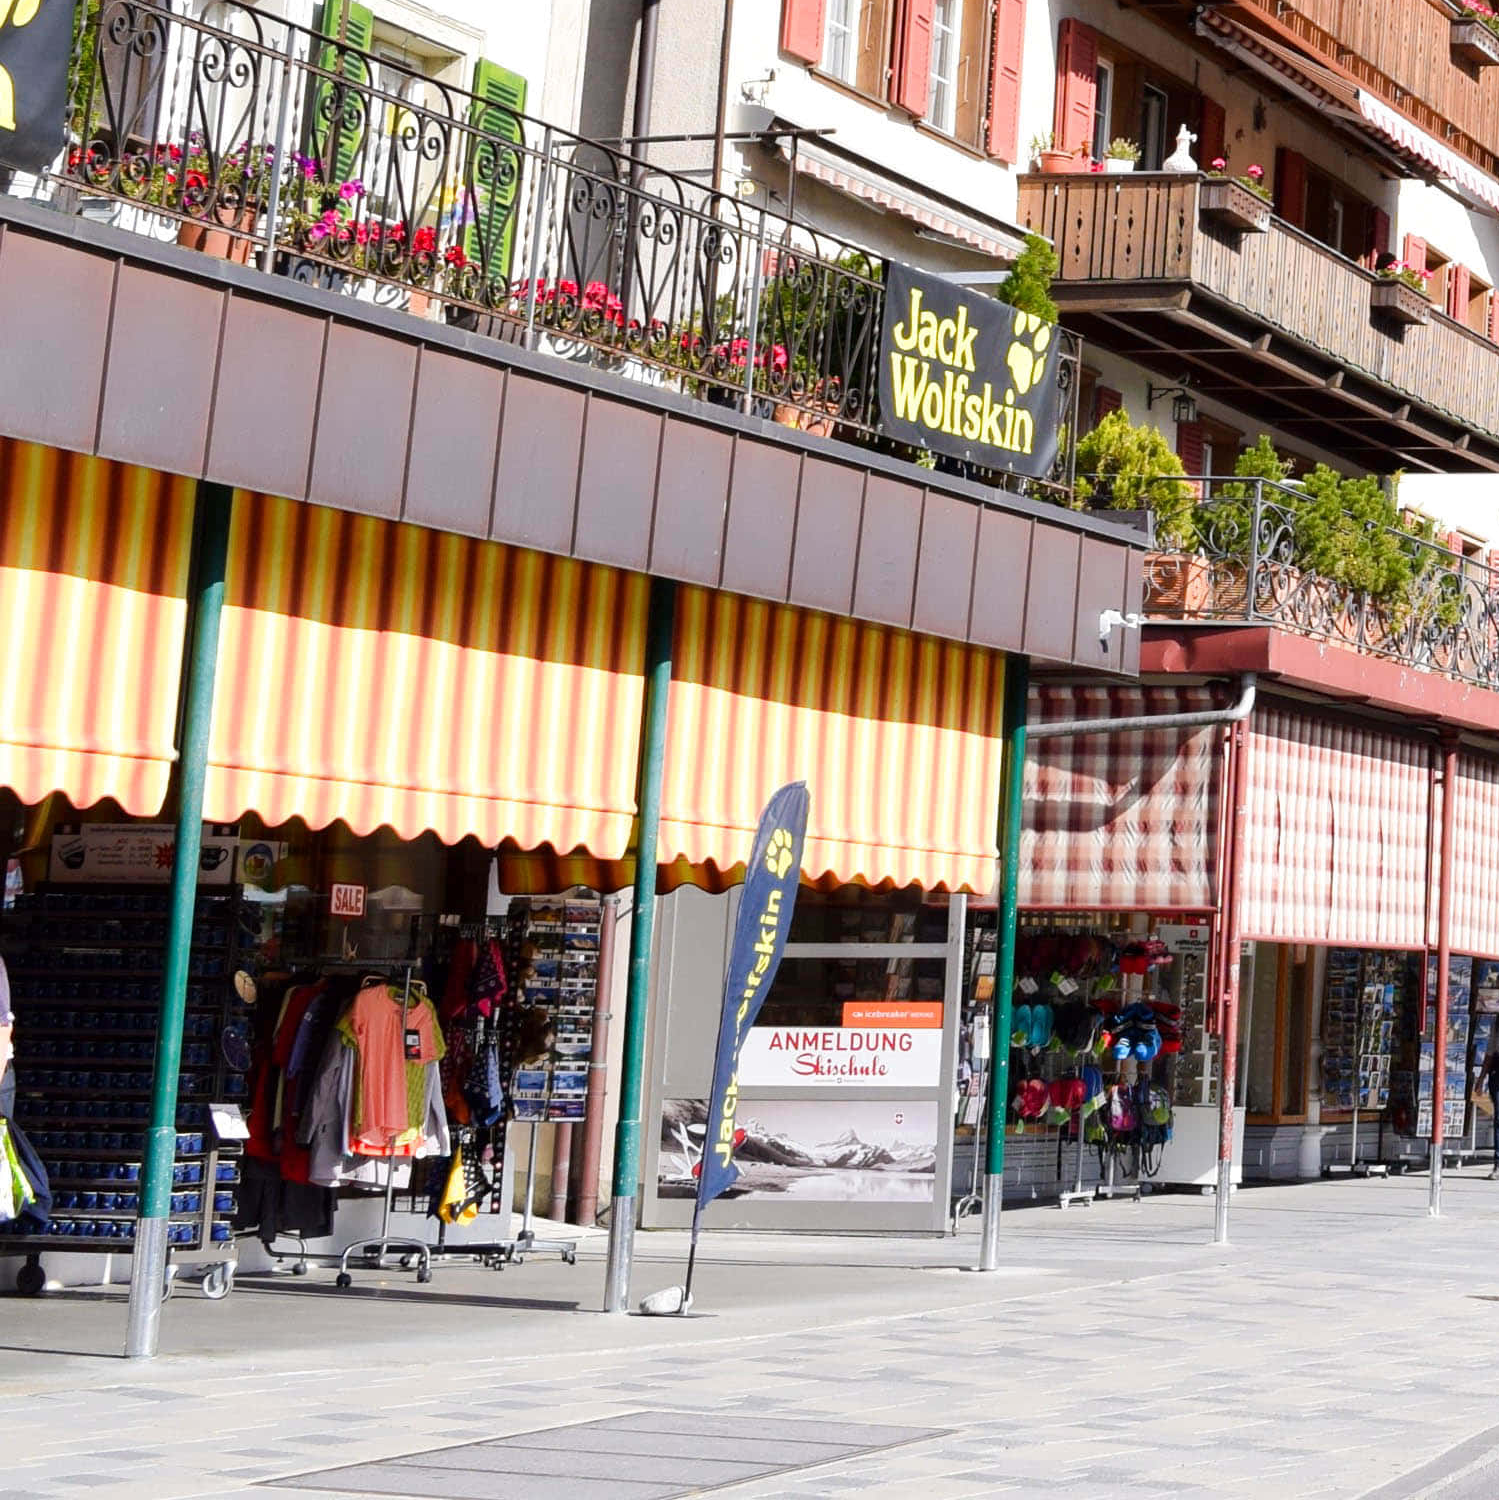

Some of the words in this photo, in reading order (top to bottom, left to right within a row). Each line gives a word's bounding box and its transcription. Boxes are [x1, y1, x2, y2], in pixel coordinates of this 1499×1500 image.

[893, 288, 979, 373] Jack
[891, 351, 1034, 455] Wolfskin
[335, 887, 362, 912] SALE
[769, 1032, 913, 1052] ANMELDUNG
[791, 1053, 888, 1076] Skischule
